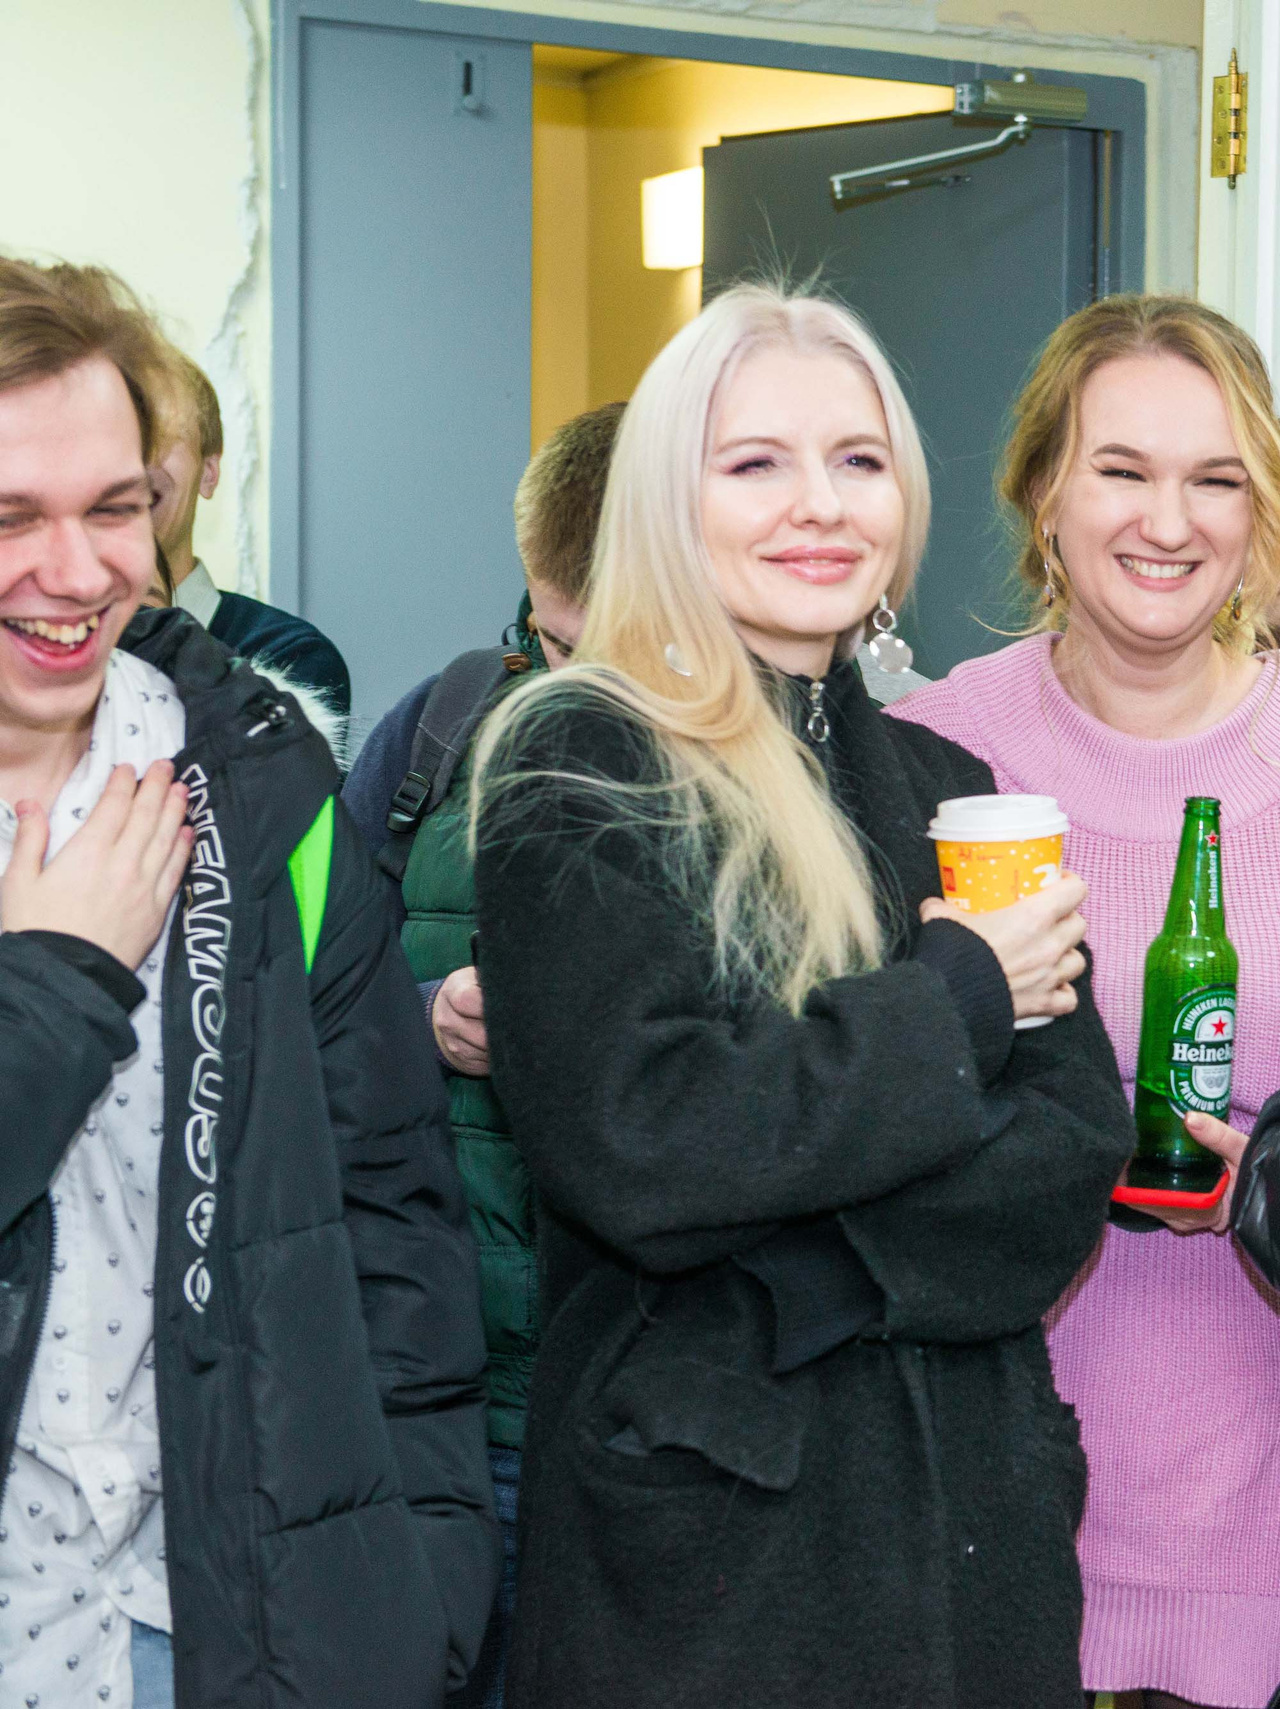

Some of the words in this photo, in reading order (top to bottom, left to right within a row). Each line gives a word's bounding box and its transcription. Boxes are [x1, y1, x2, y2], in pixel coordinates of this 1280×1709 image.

[1208, 850, 1218, 908] Heineken
[1182, 998, 1218, 1031] HEINEKEN
[1178, 1081, 1215, 1111] PREMIUM
